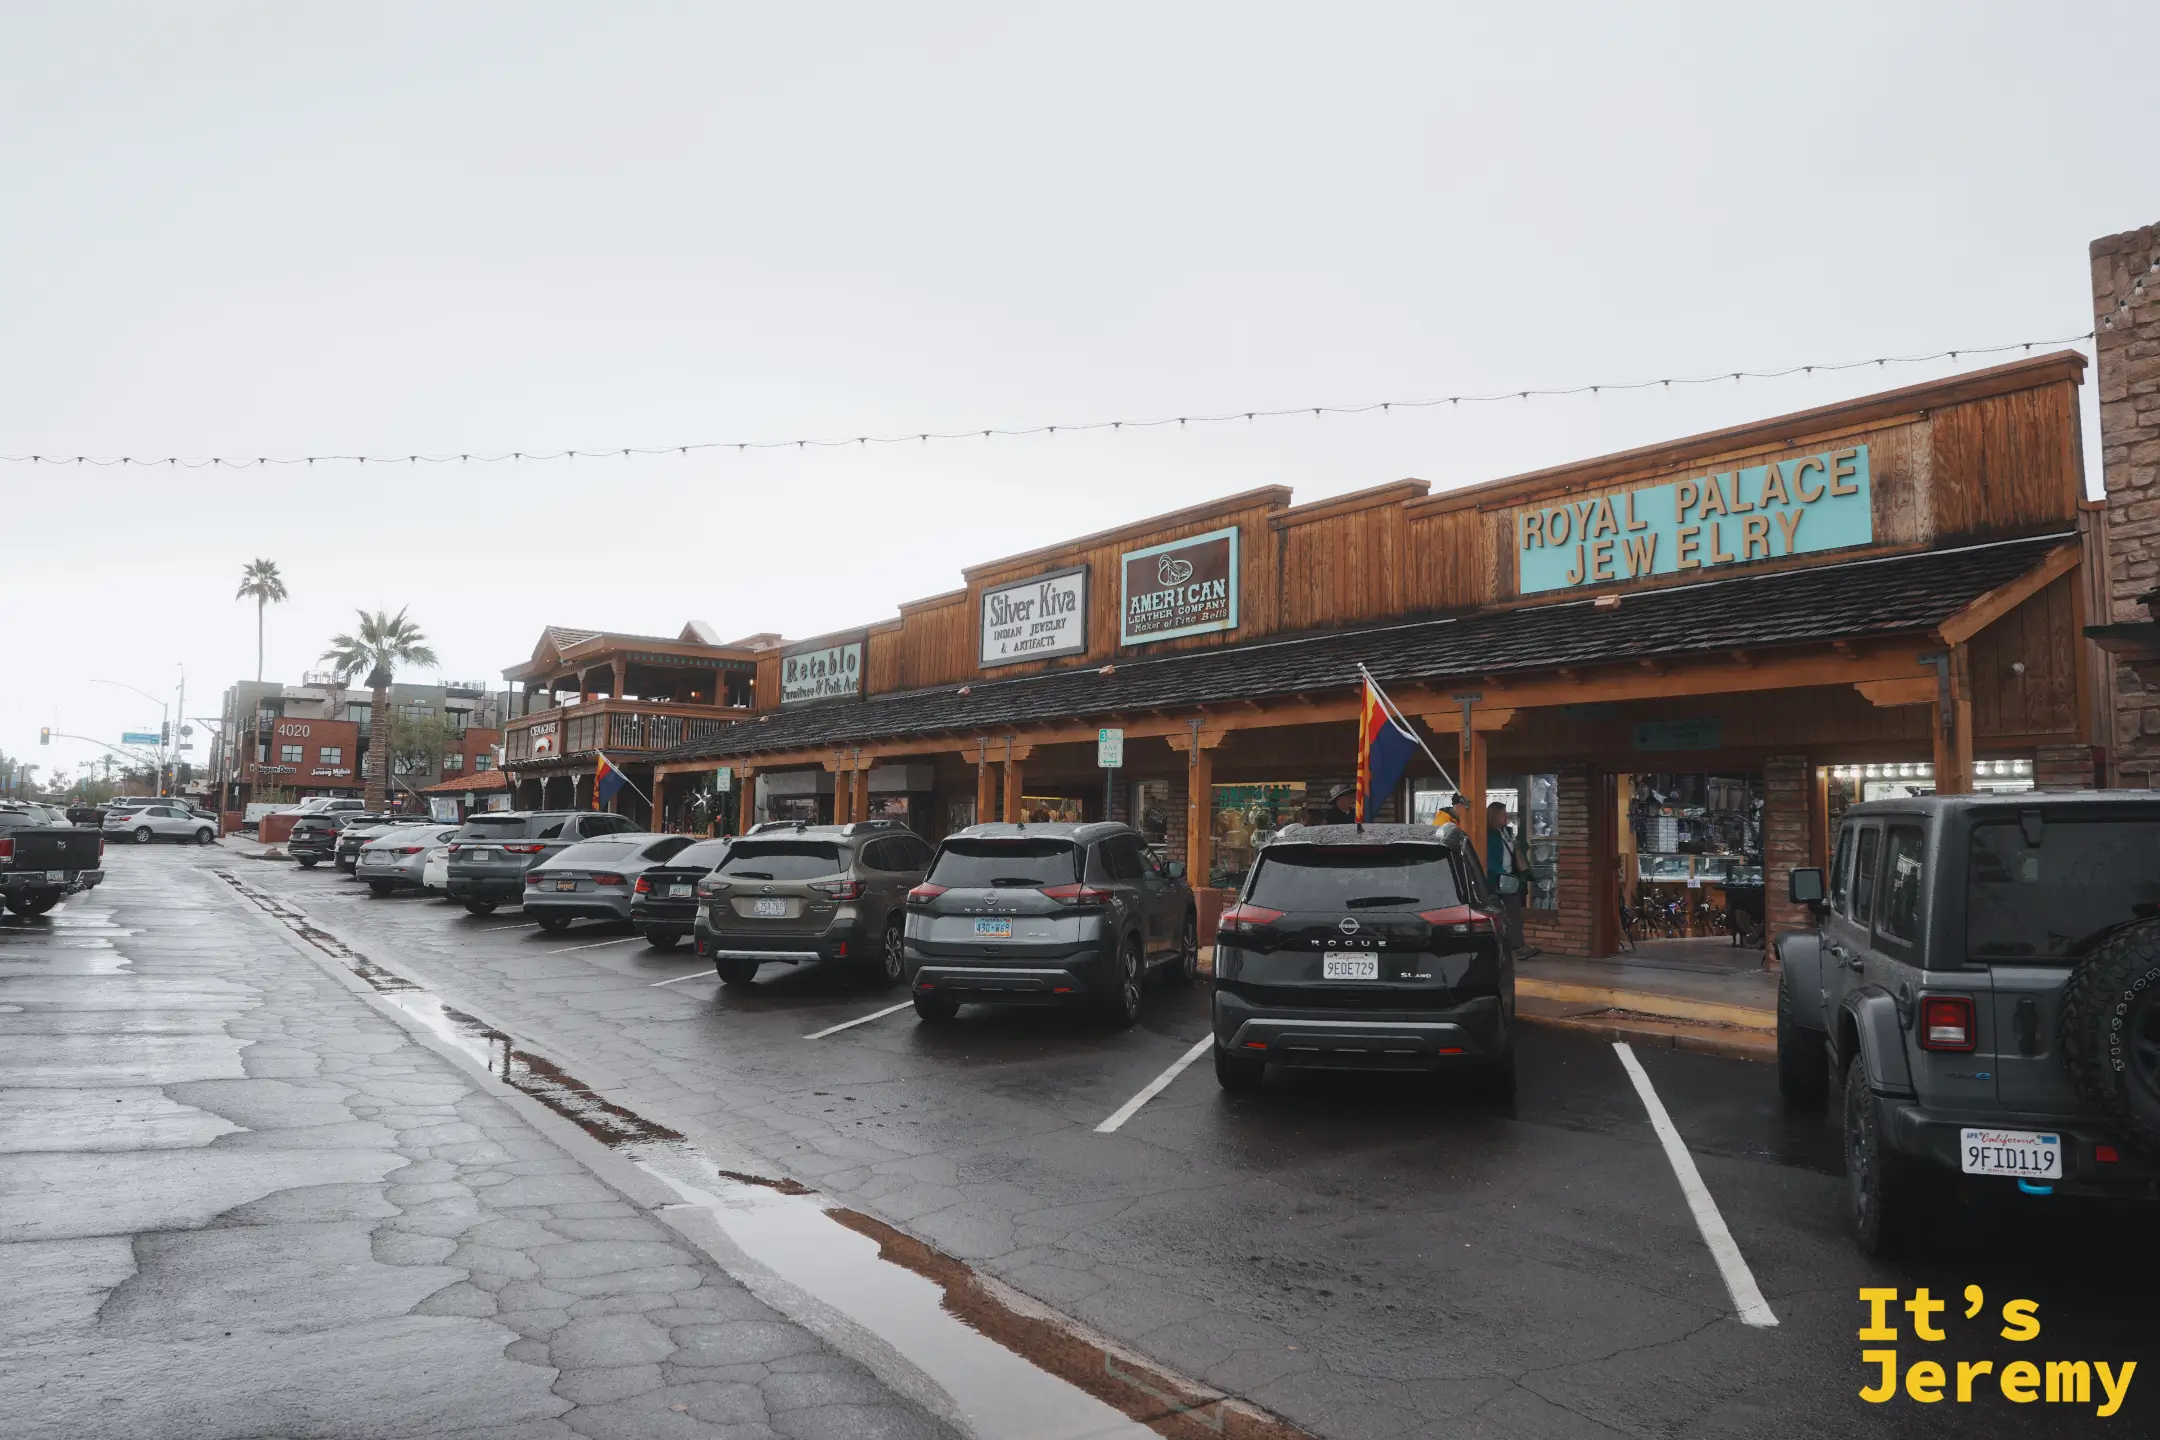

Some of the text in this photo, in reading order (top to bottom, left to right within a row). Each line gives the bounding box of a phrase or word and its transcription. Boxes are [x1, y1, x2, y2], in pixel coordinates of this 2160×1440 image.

[1520, 448, 1860, 550] ROYAL PALACE
[1566, 508, 1804, 585] JEWELRY
[990, 582, 1076, 627] Silver Kiva
[1129, 578, 1226, 615] AMERICAN
[1128, 599, 1226, 624] LEATHER COMPANY
[1164, 619, 1172, 628] of
[1175, 615, 1197, 626] Fine
[1200, 609, 1228, 621] Belts
[993, 617, 1067, 641] INDIAN JEWELRY
[1013, 635, 1056, 652] ARTIFACTS
[786, 646, 856, 684] Retablo
[782, 685, 815, 700] Furniture
[824, 677, 842, 695] Folk
[843, 675, 859, 692] Art
[278, 723, 310, 738] 4020
[1966, 1132, 1979, 1140] APR
[1981, 1131, 2037, 1146] California
[1968, 1146, 2055, 1172] 9FID119
